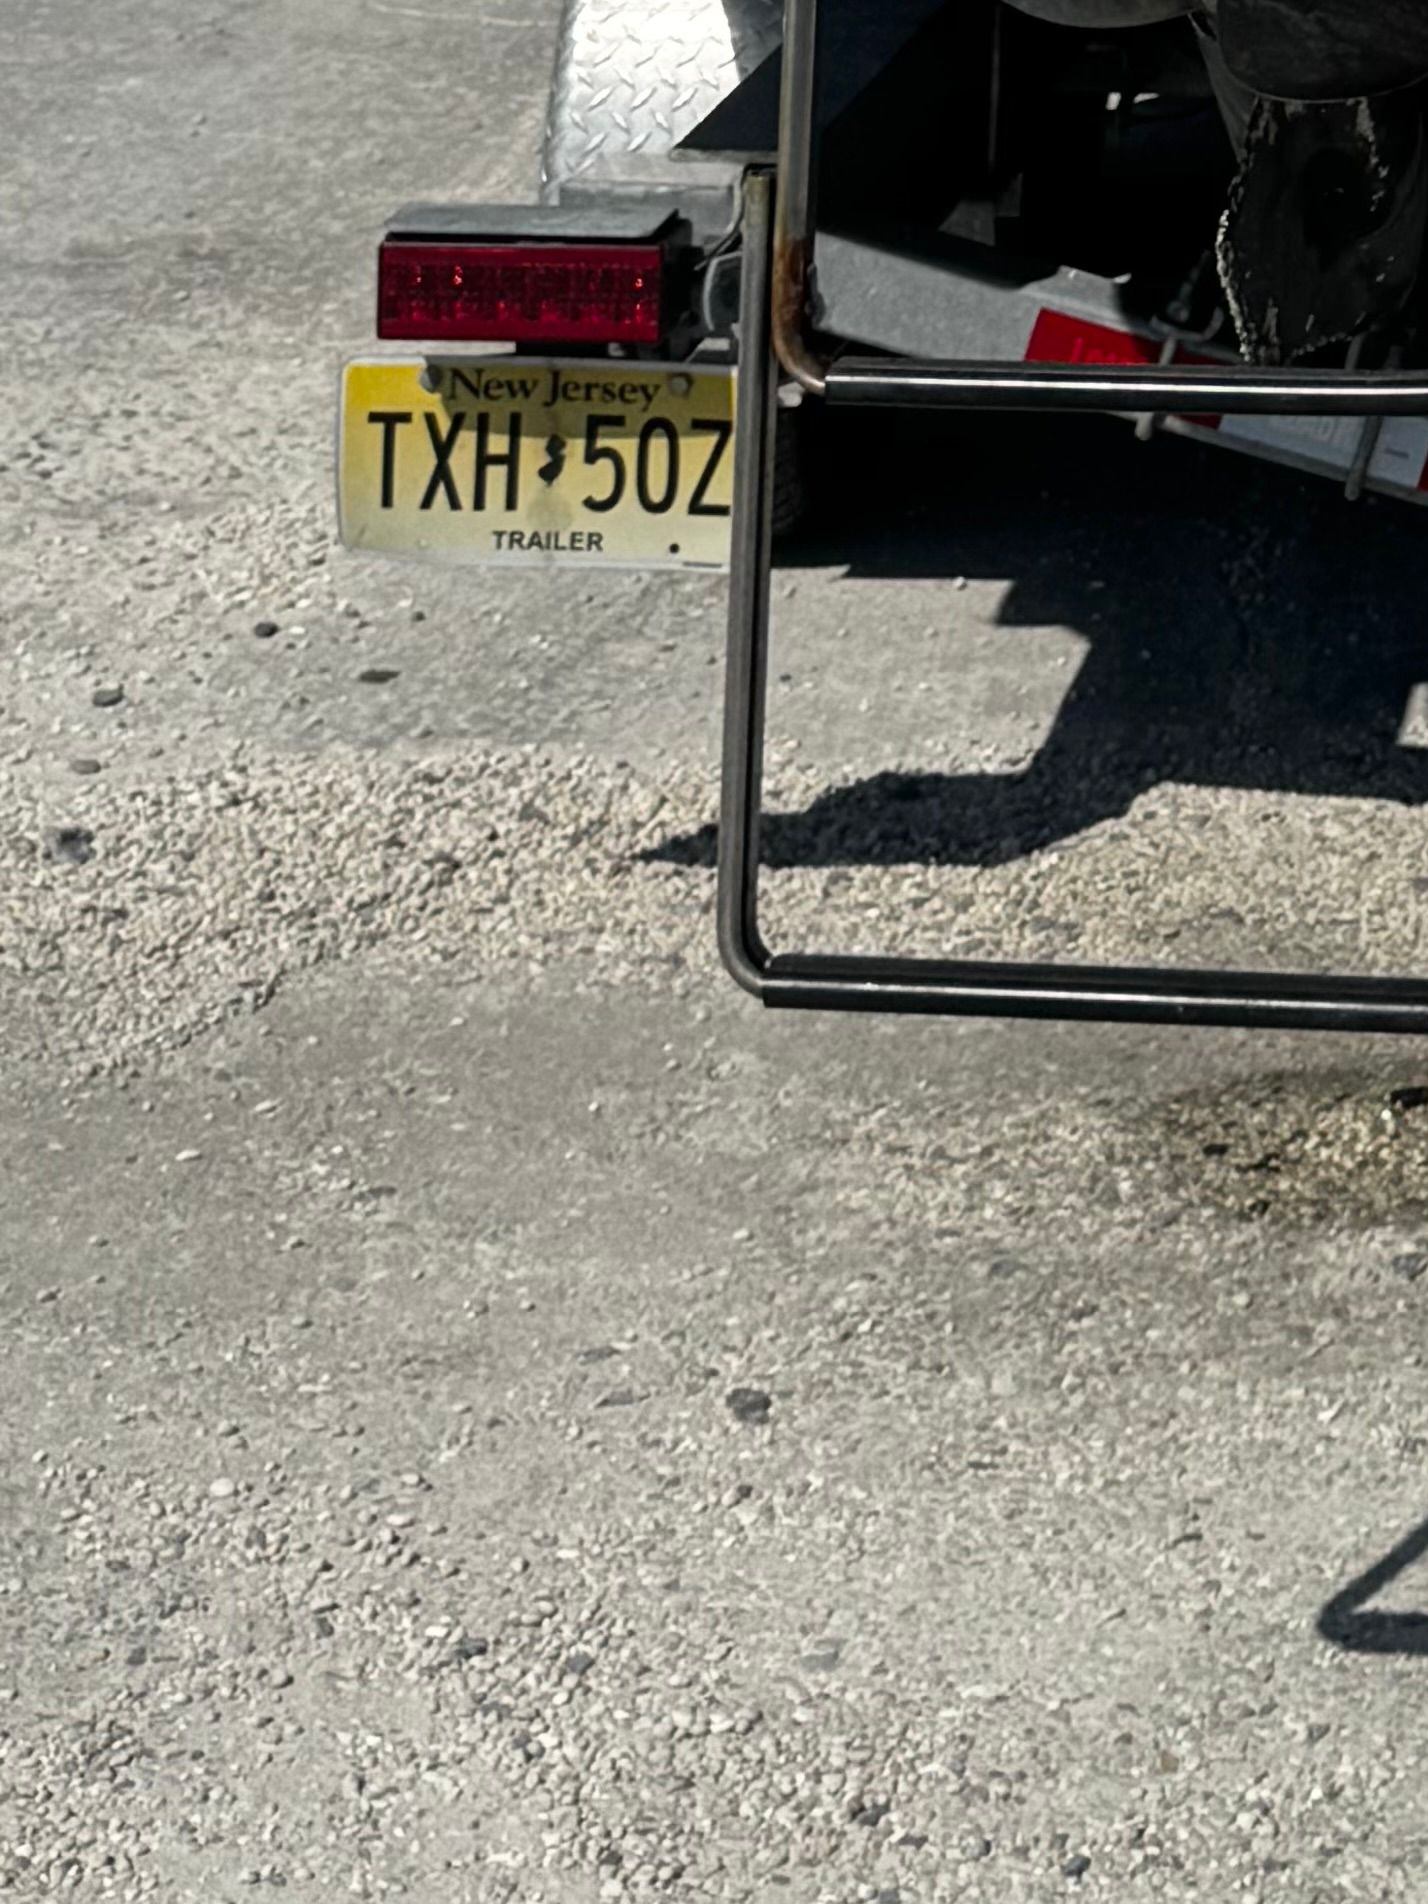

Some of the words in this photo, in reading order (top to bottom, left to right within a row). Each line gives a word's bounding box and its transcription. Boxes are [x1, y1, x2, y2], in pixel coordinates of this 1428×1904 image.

[448, 367, 539, 400] New
[543, 369, 662, 413] Jersey
[367, 411, 523, 512] TXH
[582, 414, 733, 517] 50Z
[491, 529, 604, 552] TRAILER
